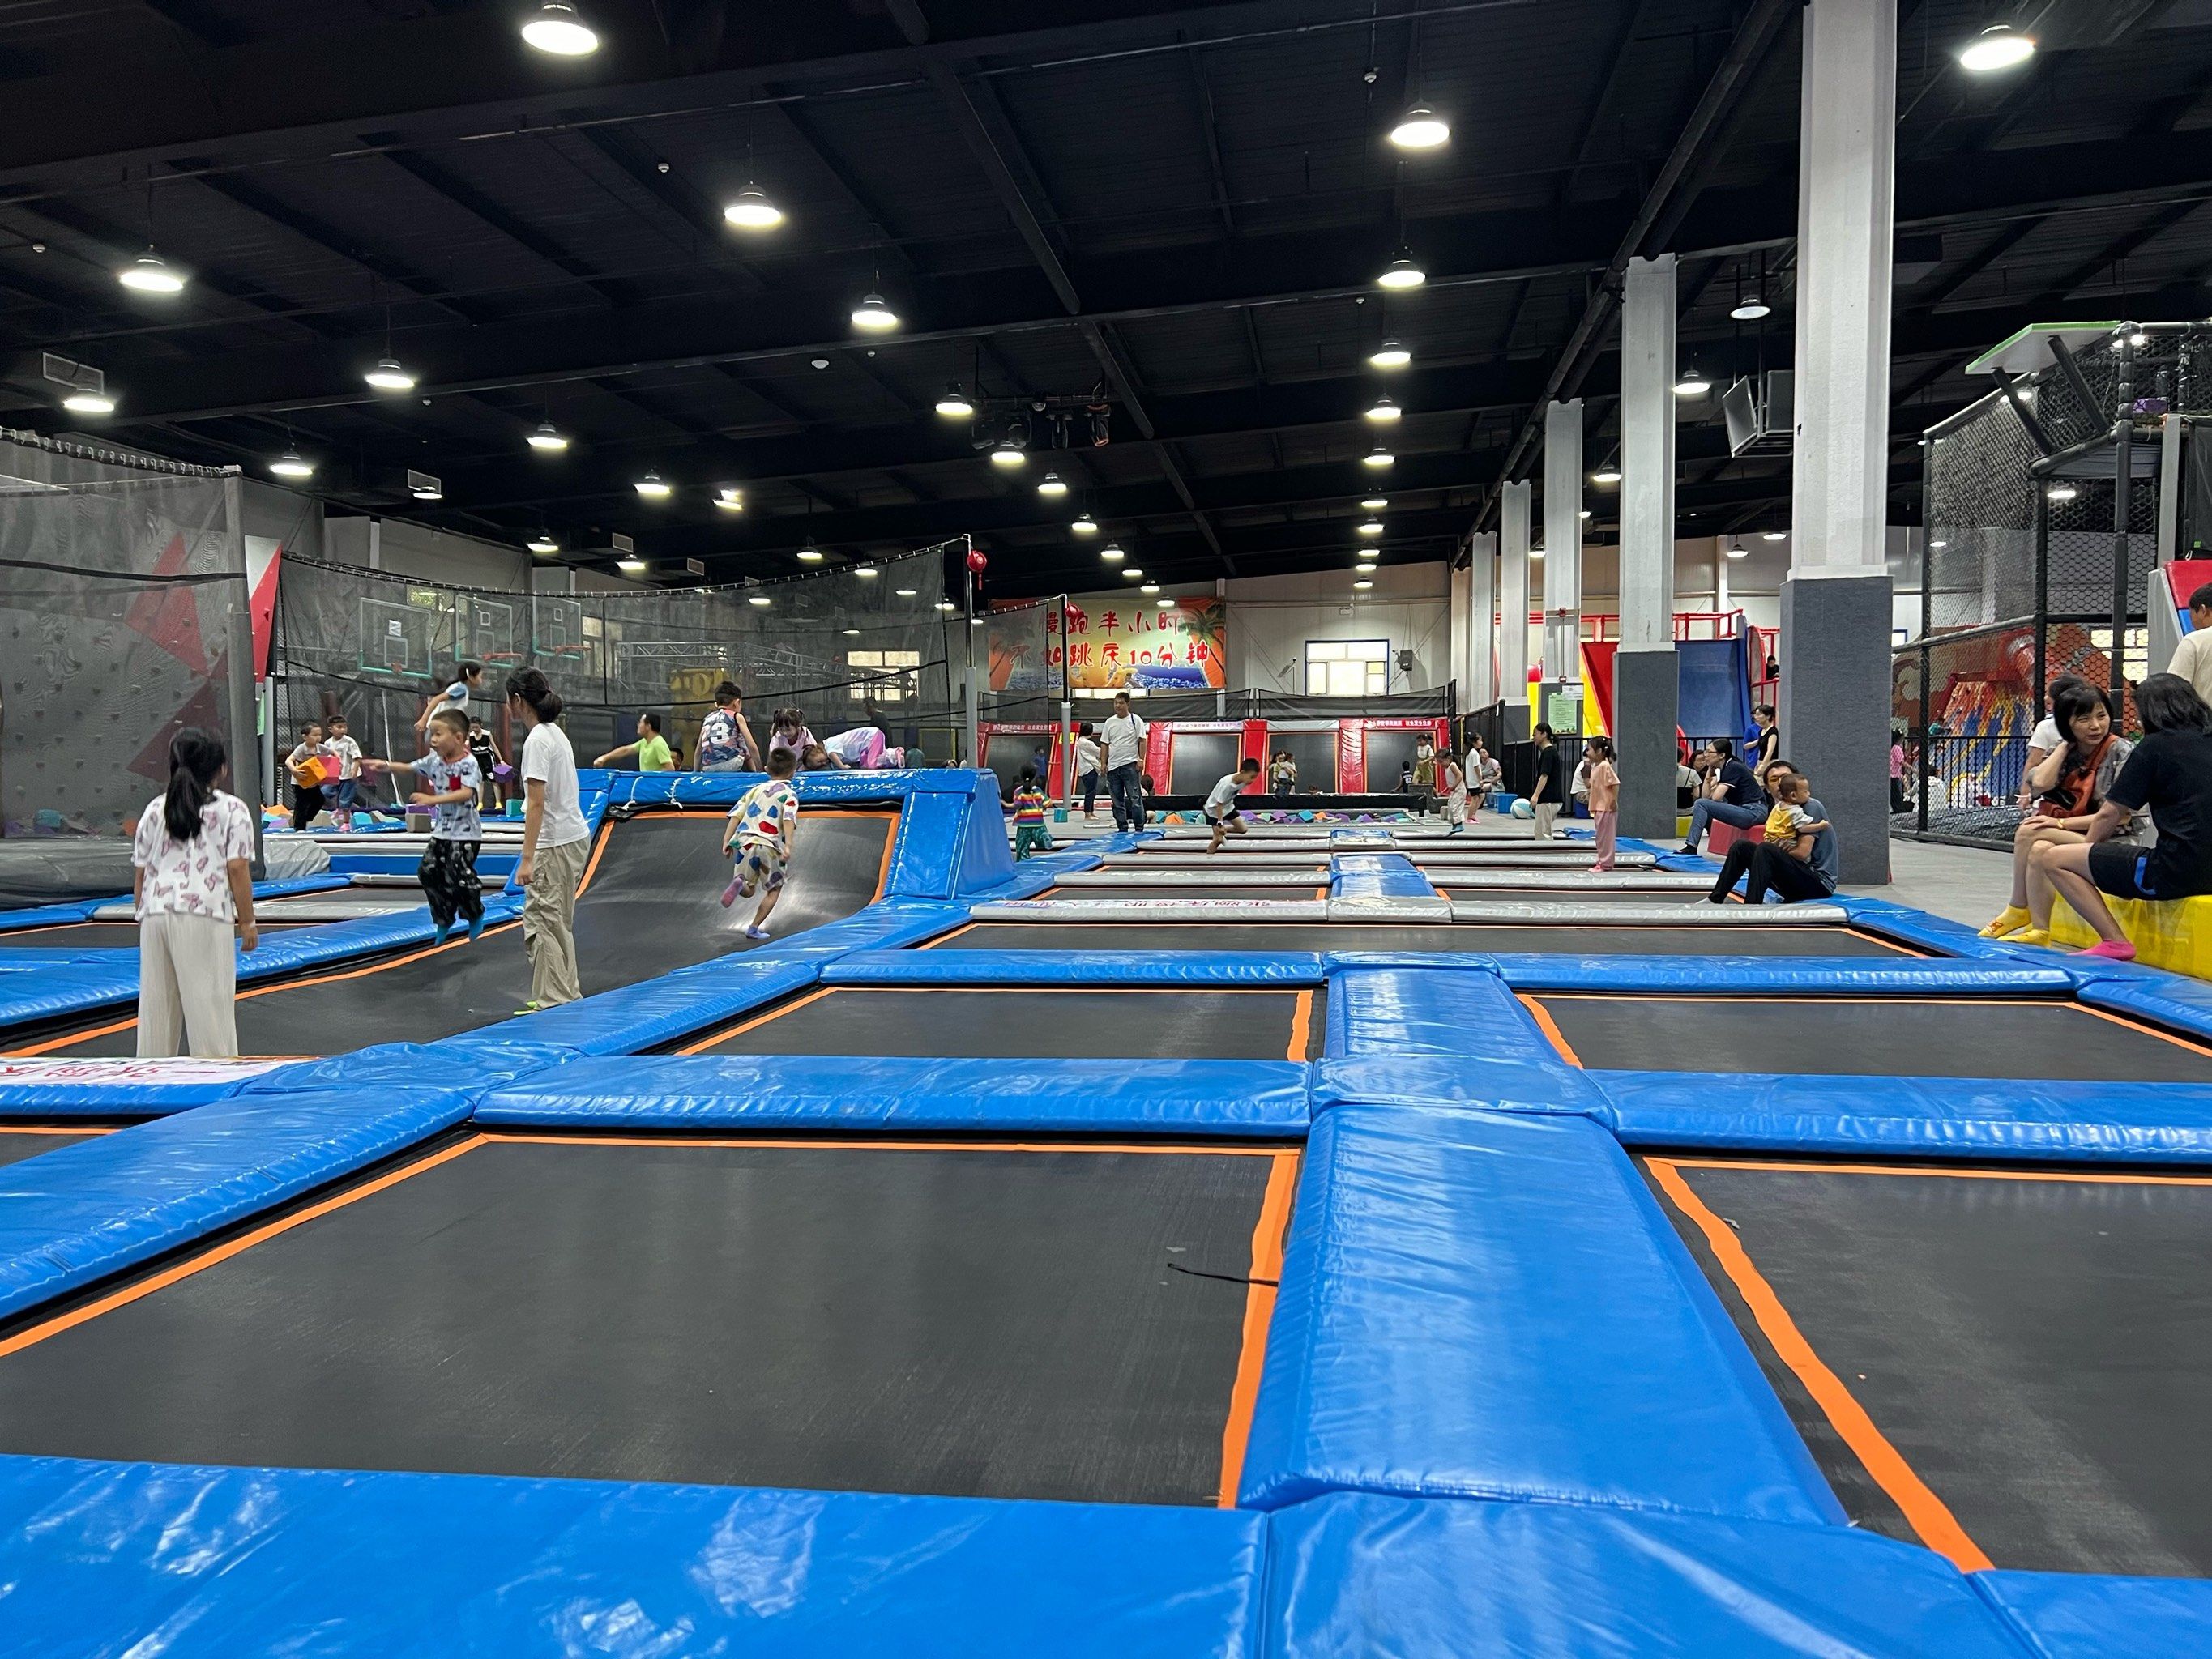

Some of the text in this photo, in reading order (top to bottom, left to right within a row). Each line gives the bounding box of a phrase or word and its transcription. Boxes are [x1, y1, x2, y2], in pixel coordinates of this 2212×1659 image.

[1040, 610, 1181, 638] 慢跑半小时
[1010, 641, 1211, 669] 不如跳床10分钟
